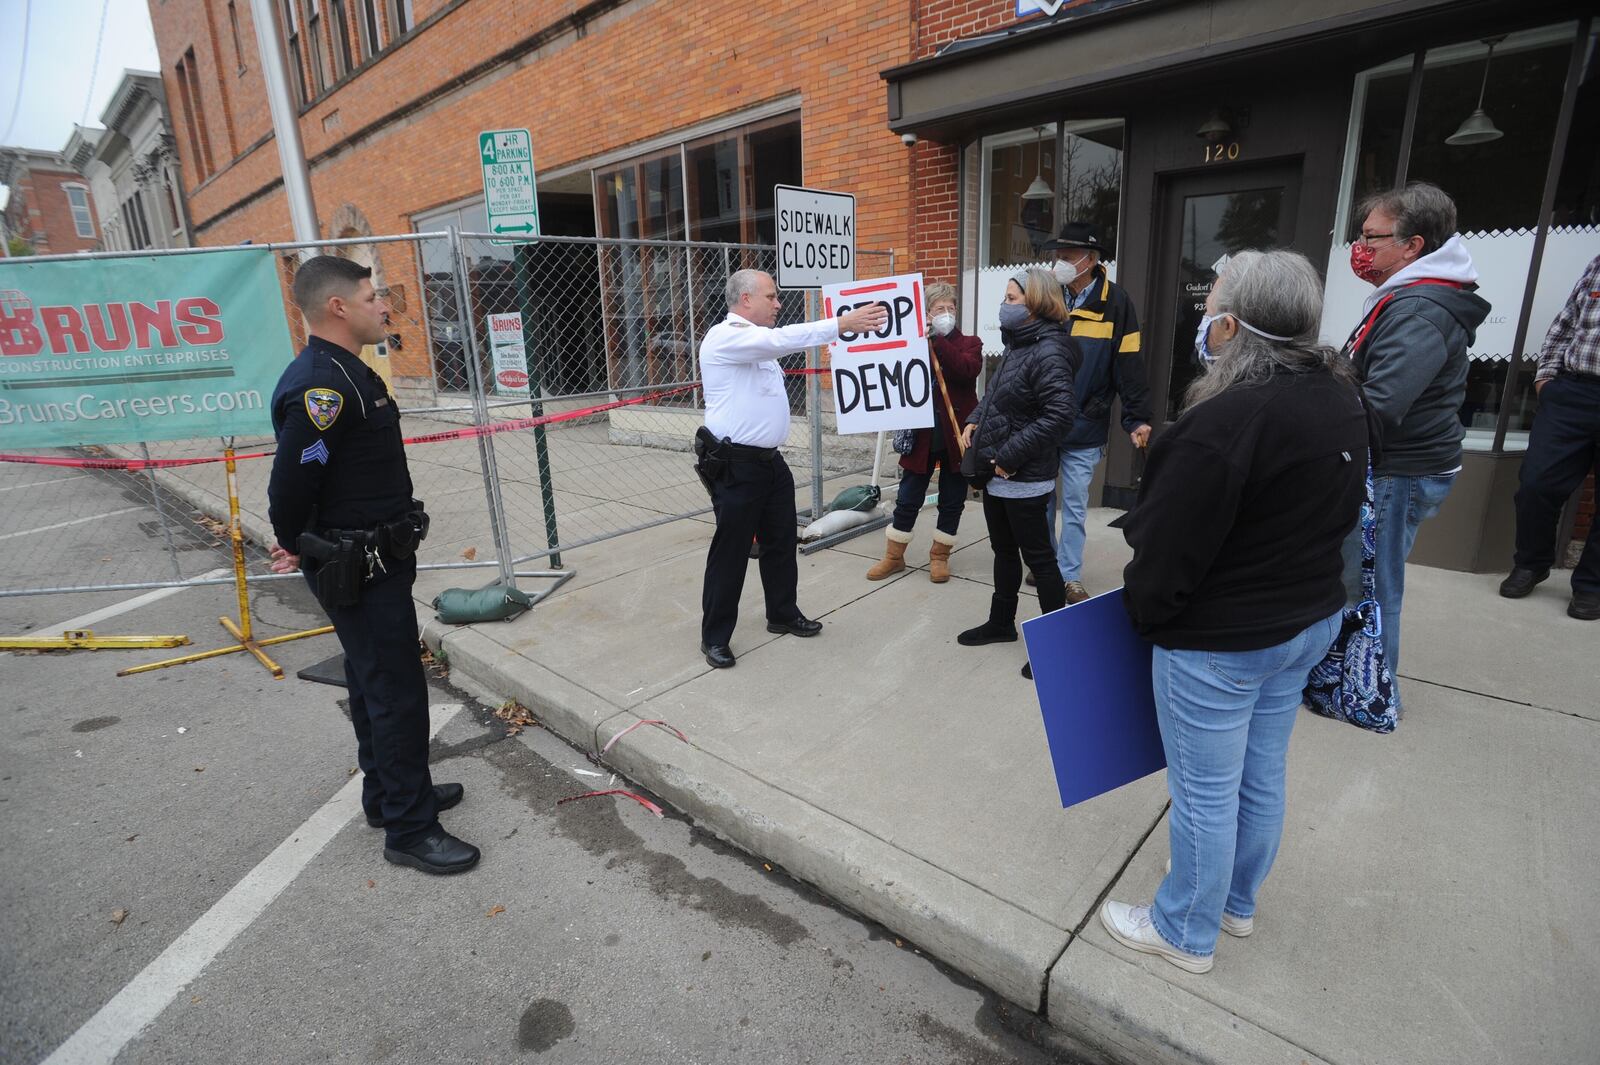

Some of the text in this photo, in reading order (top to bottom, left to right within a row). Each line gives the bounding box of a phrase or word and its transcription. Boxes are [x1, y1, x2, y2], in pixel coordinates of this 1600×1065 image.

[483, 134, 518, 160] 4 HR
[497, 147, 528, 159] PARKING
[1205, 142, 1239, 163] 120
[487, 177, 496, 188] TO
[780, 210, 851, 237] SIDEWALK
[782, 242, 850, 270] CLOSED
[0, 289, 225, 357] BRUNS
[0, 349, 229, 374] CONSTRUCTION ENTERPRISES
[835, 358, 930, 414] DEMO
[0, 389, 263, 424] BrunsCareers.com
